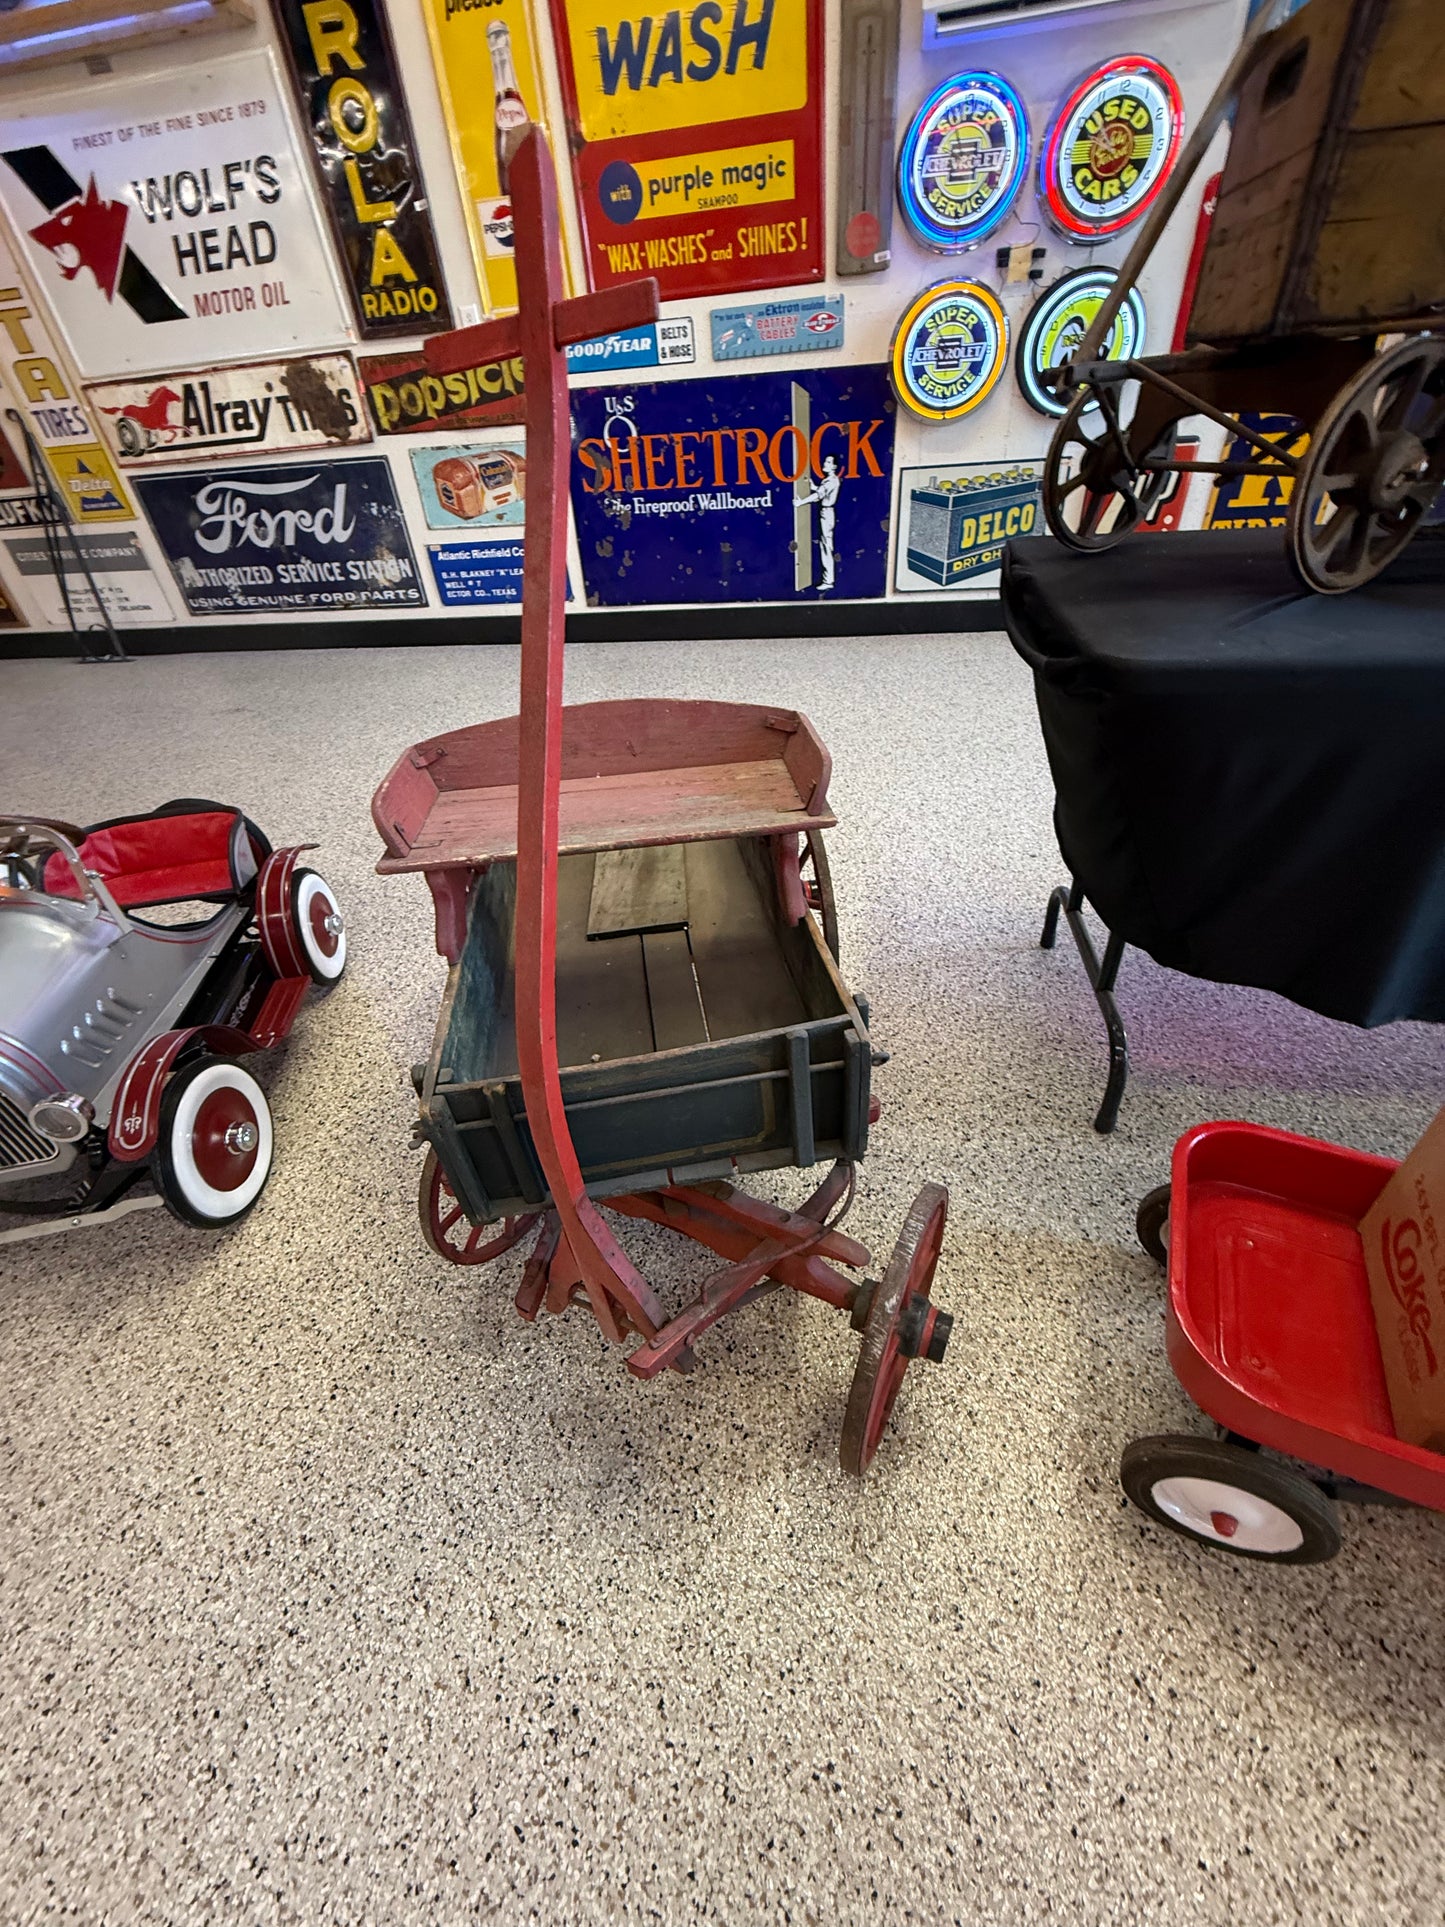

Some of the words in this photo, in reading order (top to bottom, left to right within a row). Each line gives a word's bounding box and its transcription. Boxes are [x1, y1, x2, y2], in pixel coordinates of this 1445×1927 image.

[596, 0, 775, 96] WASH
[72, 131, 113, 151] FINEST
[118, 127, 135, 143] OF
[139, 121, 161, 138] THE
[165, 115, 193, 133] FINE
[197, 107, 234, 127] SINCE
[238, 100, 266, 117] 1879
[937, 103, 997, 136] SUPER
[1085, 98, 1149, 134] USED
[926, 151, 1004, 173] CHEVROLET
[130, 154, 282, 224] WOLF'S
[648, 165, 713, 206] purple
[722, 155, 787, 190] magic
[1075, 164, 1139, 200] CARS
[698, 193, 739, 209] SHAMPOO
[928, 183, 993, 217] SERVICE
[171, 220, 276, 277] HEAD
[598, 228, 714, 273] "WAX-WASHES"
[711, 242, 733, 261] and
[737, 217, 808, 258] SHINES!
[194, 286, 256, 318] MOTOR
[261, 281, 290, 308] OIL
[361, 286, 438, 319] RADIO
[660, 325, 688, 340] BELTS
[756, 315, 799, 330] BATTERY
[760, 328, 796, 341] CABLES
[925, 306, 979, 332] SUPER
[565, 336, 652, 359] GOODYEAR
[669, 344, 692, 358] HOSE
[918, 345, 982, 362] CHEVROLET
[918, 370, 976, 397] SERVICE
[30, 405, 89, 439] TIRES
[182, 381, 271, 441] Alray
[276, 386, 359, 434] TIS
[577, 419, 886, 494] SHEETROCK
[68, 477, 113, 493] Delta
[194, 473, 357, 554] Ford
[632, 494, 697, 518] Fireproof
[696, 489, 773, 511] Wallboard
[960, 503, 1036, 549] DELCO
[438, 550, 471, 561] Atlantic
[471, 547, 512, 559] Richfield
[952, 555, 980, 572] DRY
[276, 558, 346, 585] SERVICE
[348, 557, 414, 584] STATION
[189, 596, 234, 609] USING
[236, 594, 308, 608] GENUINE
[309, 591, 357, 604] FORD
[361, 588, 421, 602] PARTS
[491, 588, 518, 596] TEXAS
[1392, 1217, 1437, 1377] Coke
